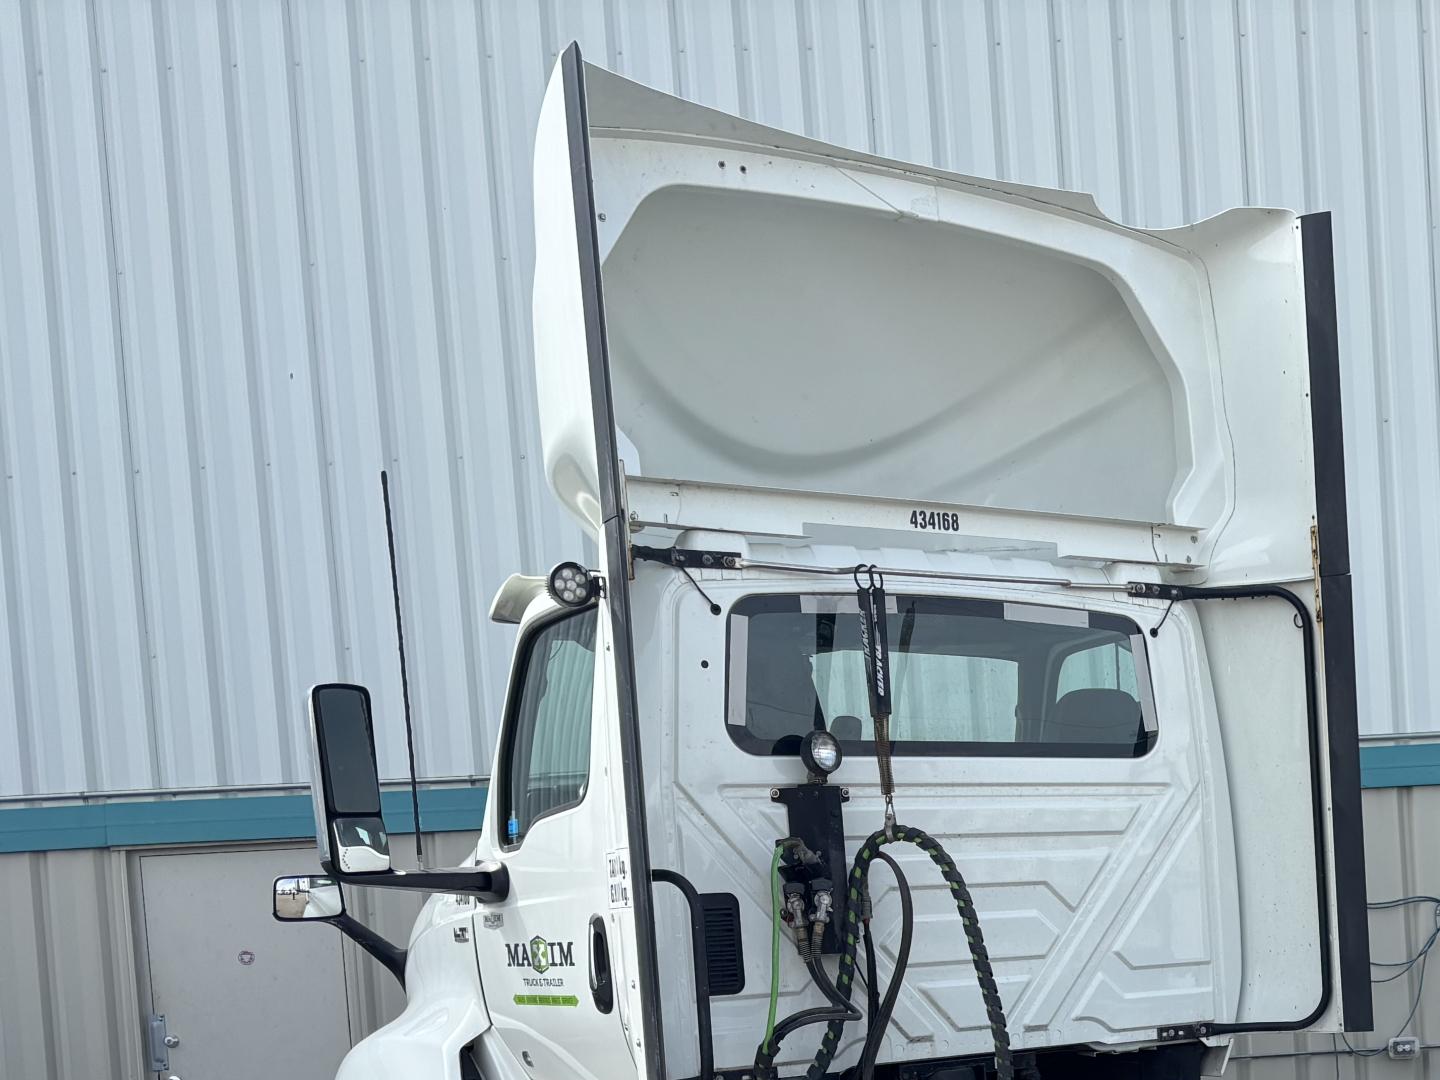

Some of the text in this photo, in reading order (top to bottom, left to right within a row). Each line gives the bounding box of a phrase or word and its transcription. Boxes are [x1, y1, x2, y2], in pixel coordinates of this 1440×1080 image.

[910, 510, 959, 531] 434168
[875, 645, 885, 697] TRACKER
[505, 938, 575, 971] MAXIM
